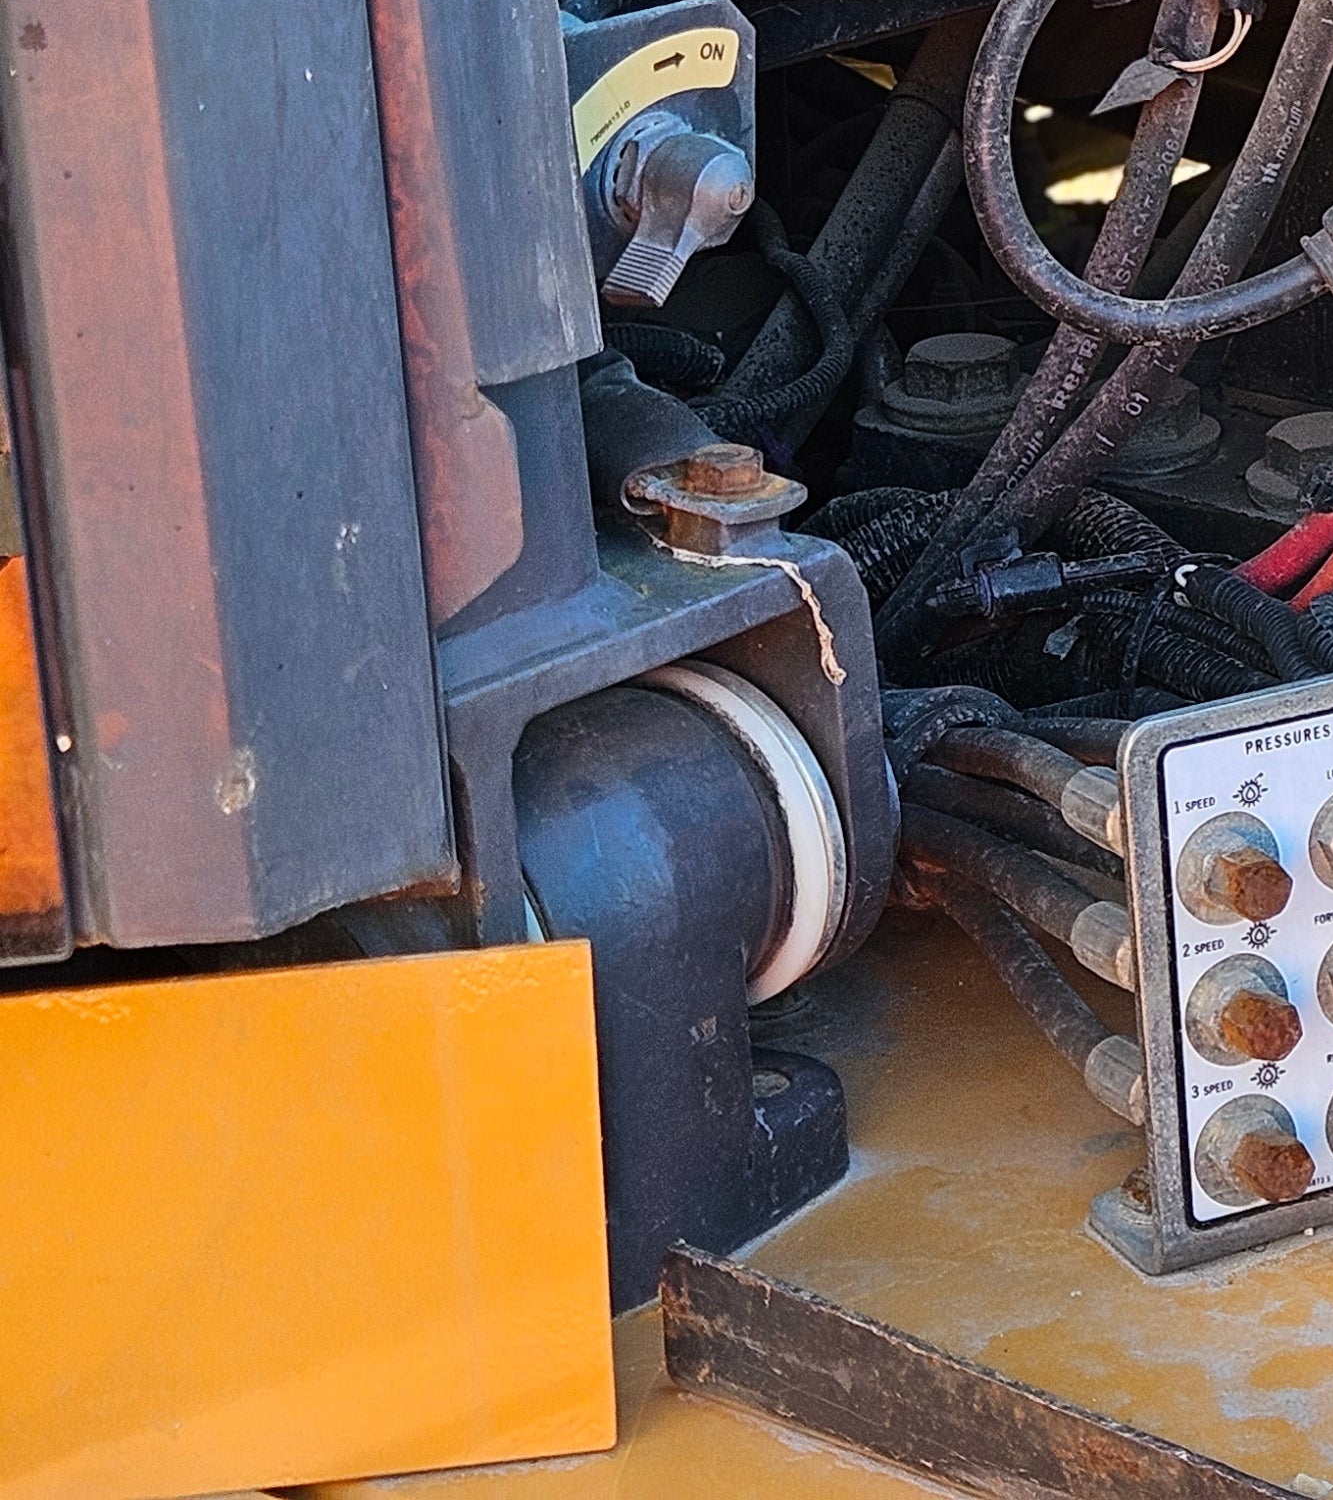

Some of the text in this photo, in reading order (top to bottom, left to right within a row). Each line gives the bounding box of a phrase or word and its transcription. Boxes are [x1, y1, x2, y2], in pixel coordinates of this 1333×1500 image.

[700, 42, 725, 61] ON
[1245, 725, 1332, 755] PRESSURES
[1174, 796, 1216, 814] 1 SPEED
[1183, 940, 1225, 957] 2 SPEED
[1191, 1079, 1234, 1098] 3 SPEED
